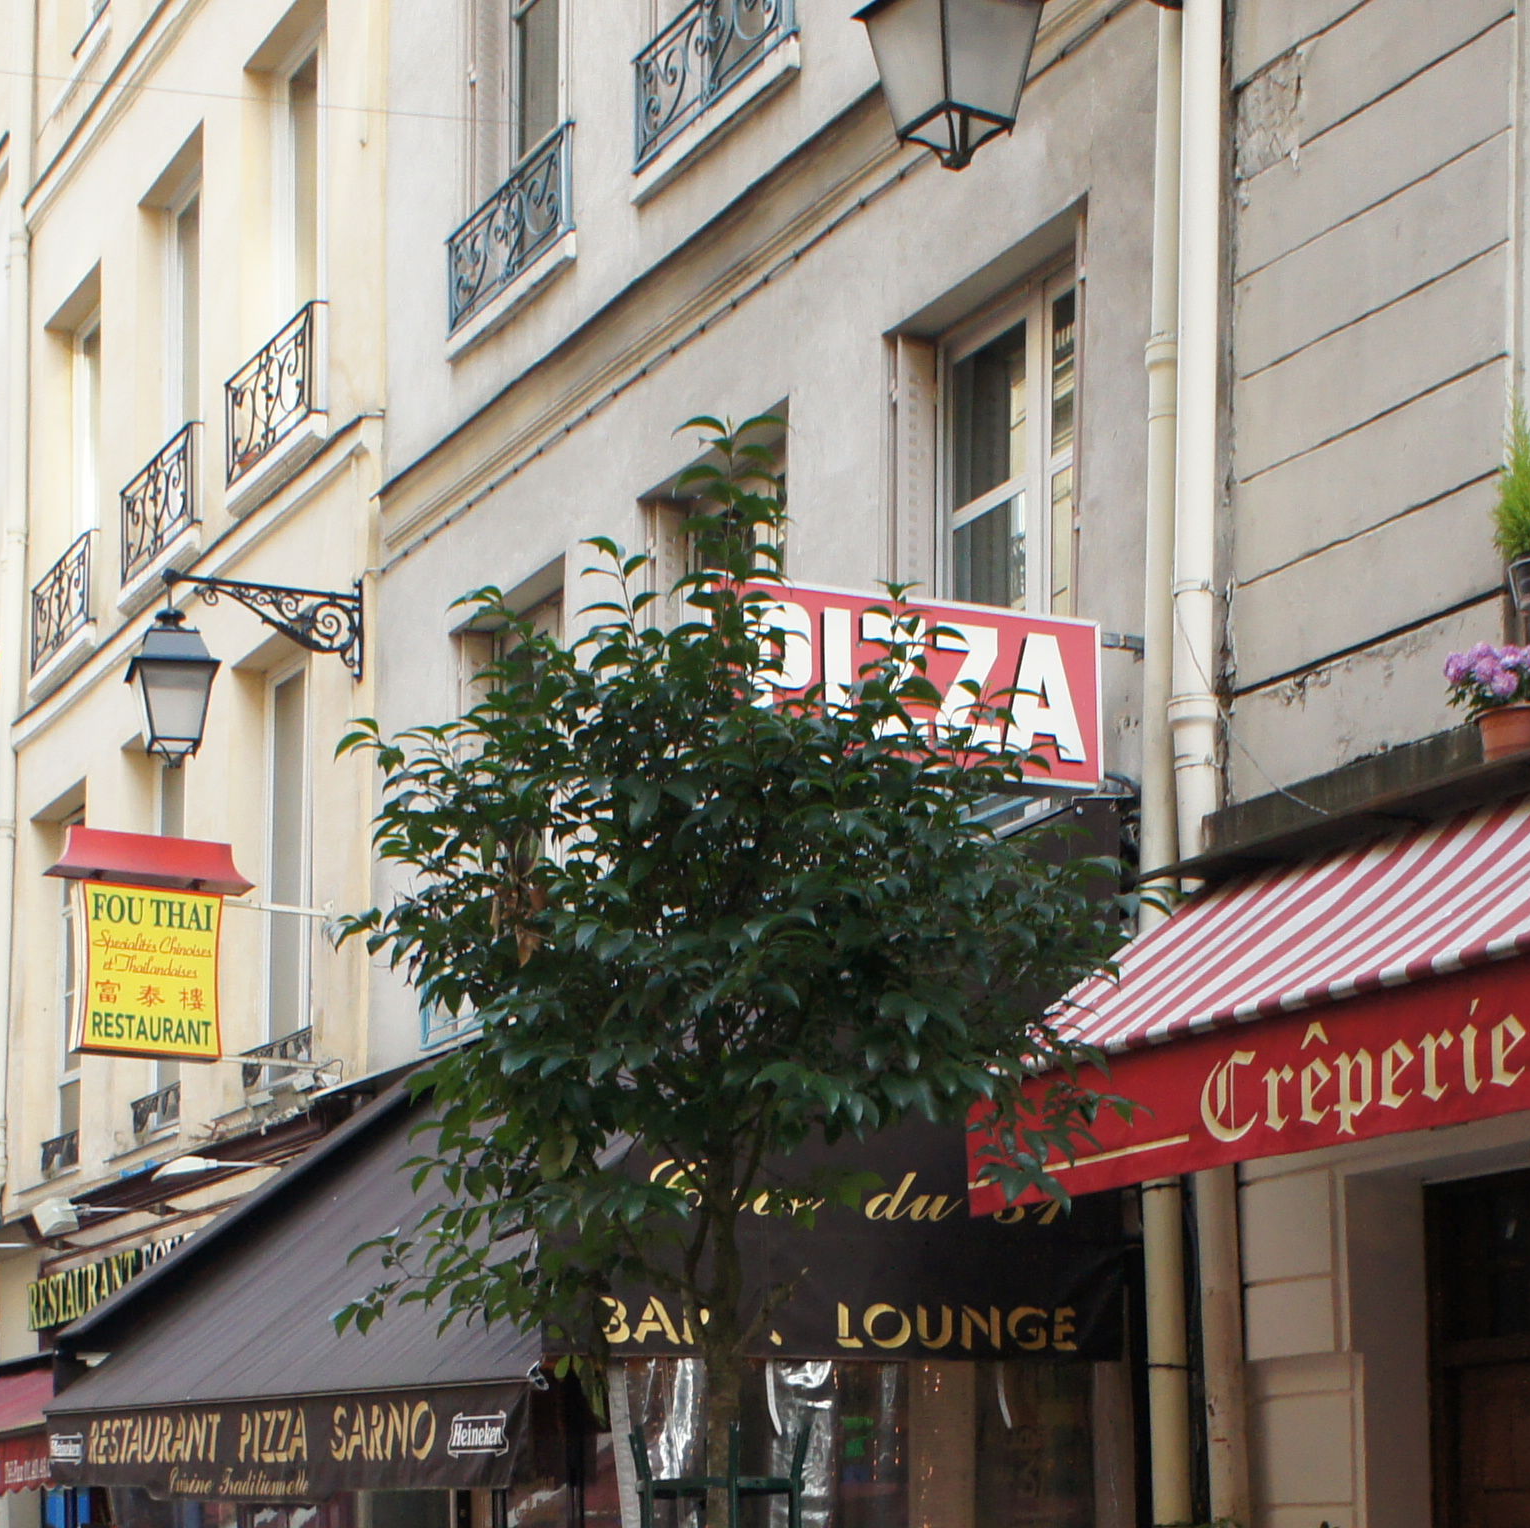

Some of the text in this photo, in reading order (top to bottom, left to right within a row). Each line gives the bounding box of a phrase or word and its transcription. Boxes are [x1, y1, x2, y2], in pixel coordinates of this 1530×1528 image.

[744, 598, 1086, 762] PIZZA
[93, 893, 213, 932] FOU THAI
[159, 937, 213, 958] Chinoises
[92, 1011, 212, 1047] RESTAURANT
[1200, 998, 1526, 1142] Crêperie
[865, 1172, 963, 1222] du
[27, 1250, 136, 1332] RESTAURANT
[837, 1303, 1077, 1351] LOUNGE
[89, 1401, 436, 1464] RESTAURANT PIZZA SARNO
[451, 1421, 503, 1447] Heineken
[169, 1466, 309, 1496] Cuisine Traditionnelle
